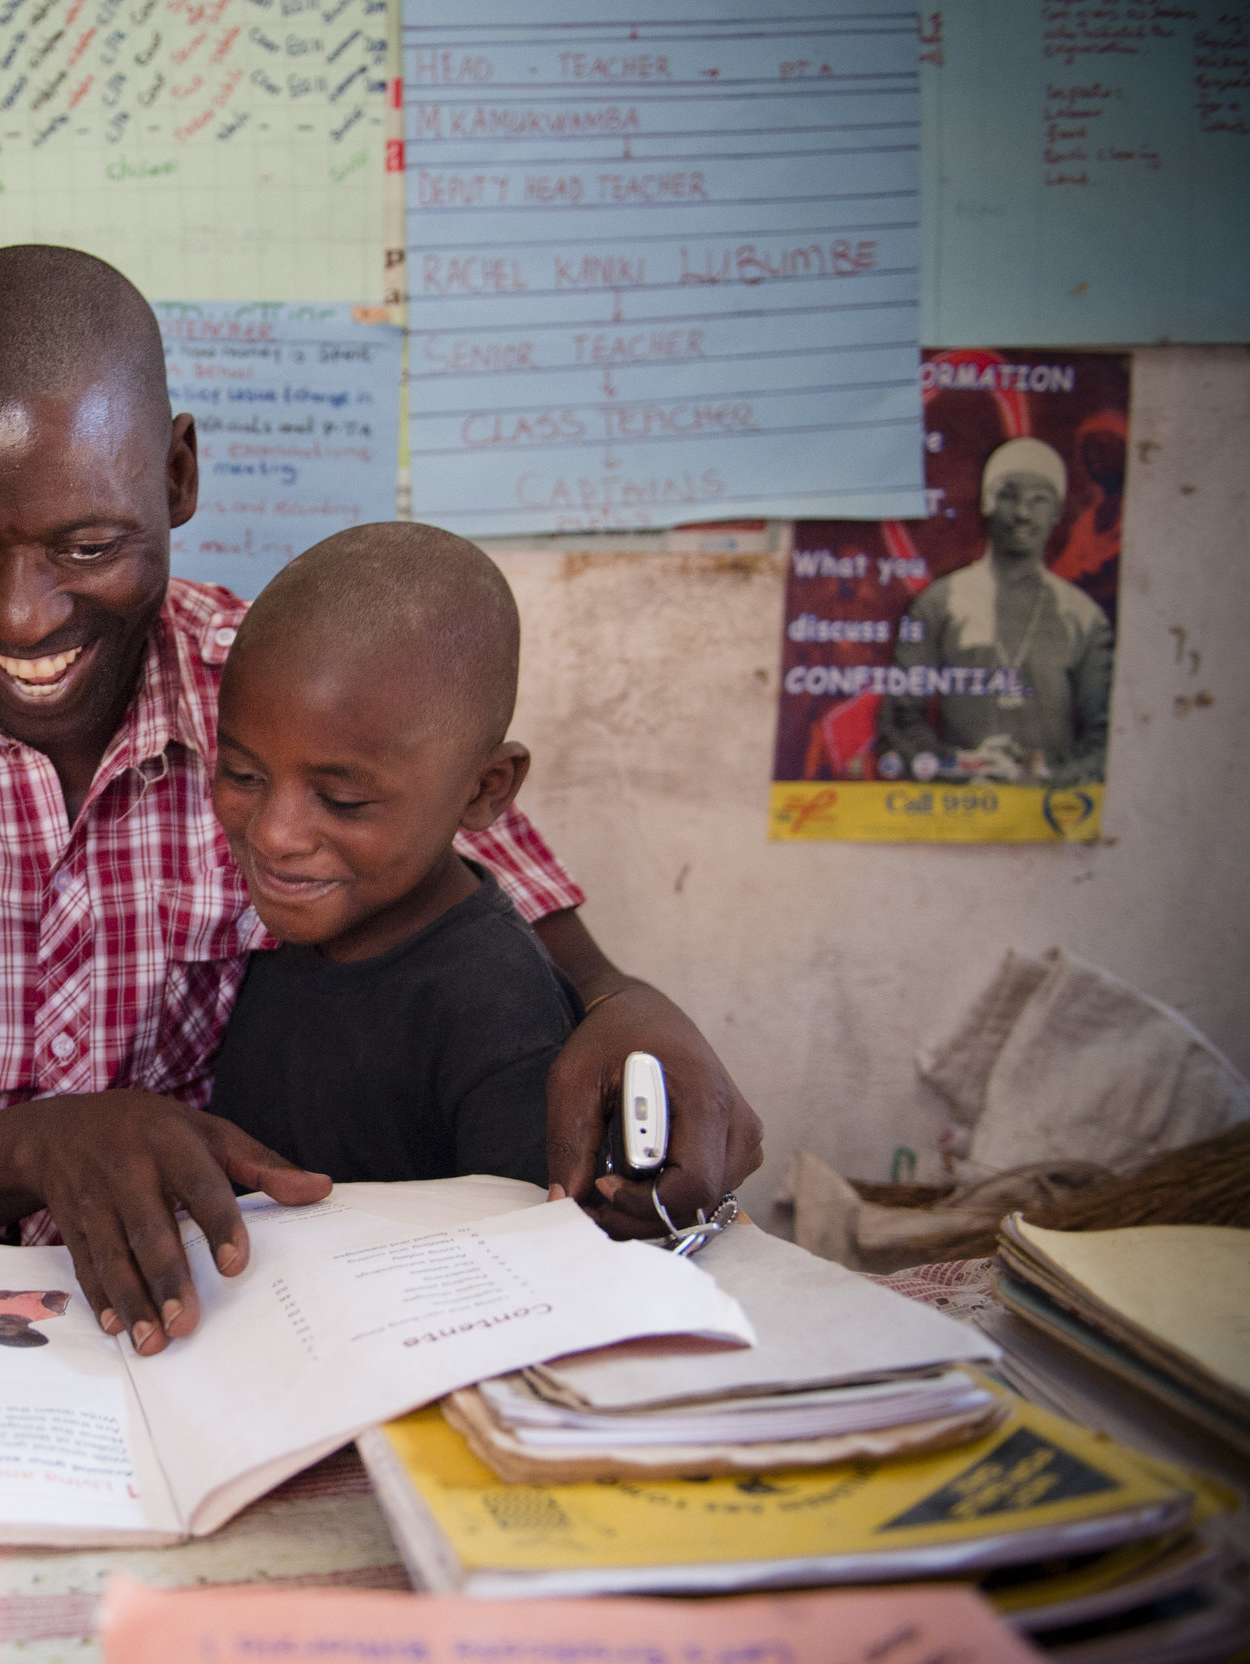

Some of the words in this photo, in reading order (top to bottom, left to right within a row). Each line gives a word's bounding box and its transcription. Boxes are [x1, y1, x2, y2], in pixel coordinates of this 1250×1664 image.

[415, 49, 493, 84] HEAD
[558, 52, 672, 81] TEACHER
[417, 170, 509, 207] DEPUTY
[523, 174, 583, 203] HEAD
[597, 171, 707, 202] TEACHER
[422, 253, 527, 294] RACHEL
[679, 239, 879, 286] LUBUMBE
[422, 338, 539, 372] SENIOR
[573, 328, 707, 364] TEACHER
[460, 409, 586, 450] CLASS
[598, 403, 761, 440] TEACHER
[792, 552, 868, 580] What
[788, 612, 890, 642] discuss
[898, 615, 924, 642] is
[402, 1301, 553, 1349] Contents
